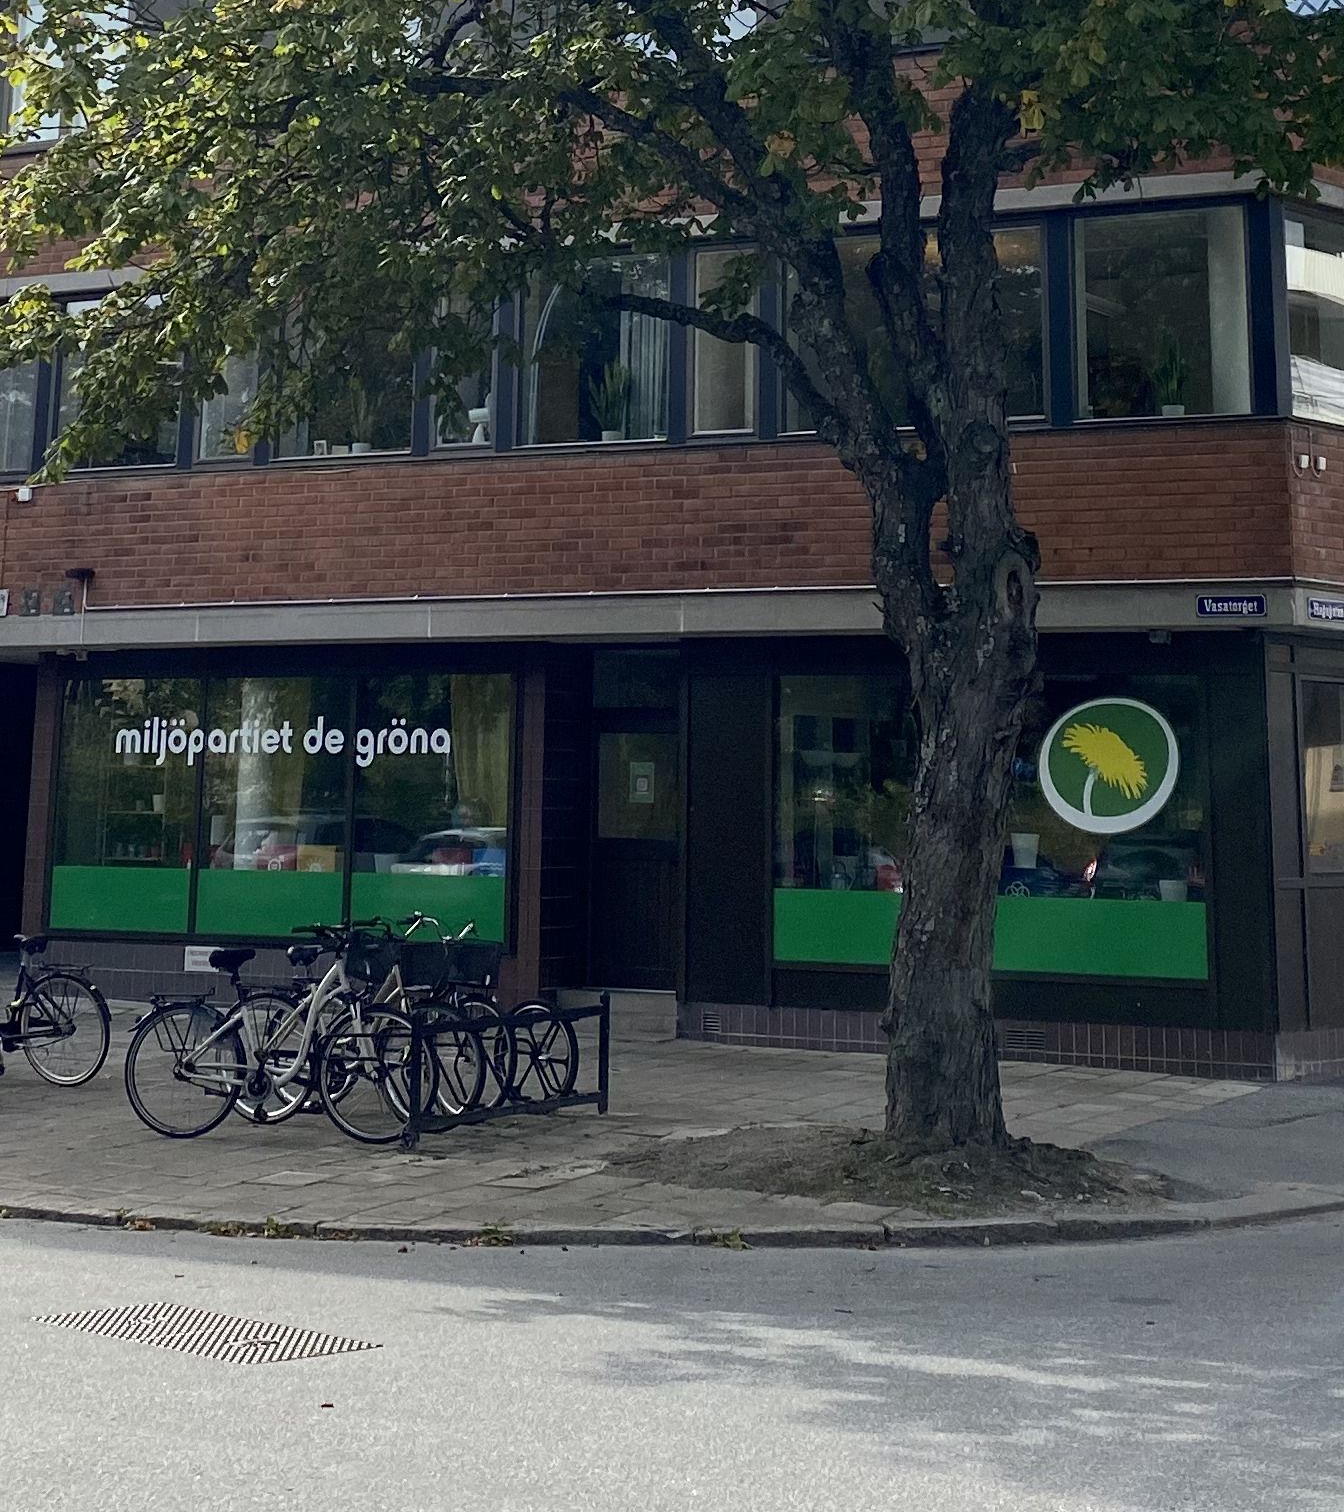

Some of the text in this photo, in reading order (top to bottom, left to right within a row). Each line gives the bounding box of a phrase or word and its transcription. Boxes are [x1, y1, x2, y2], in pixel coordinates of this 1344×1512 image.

[1203, 599, 1258, 614] Vasatorget
[115, 716, 452, 768] miljöpartiet de gröna
